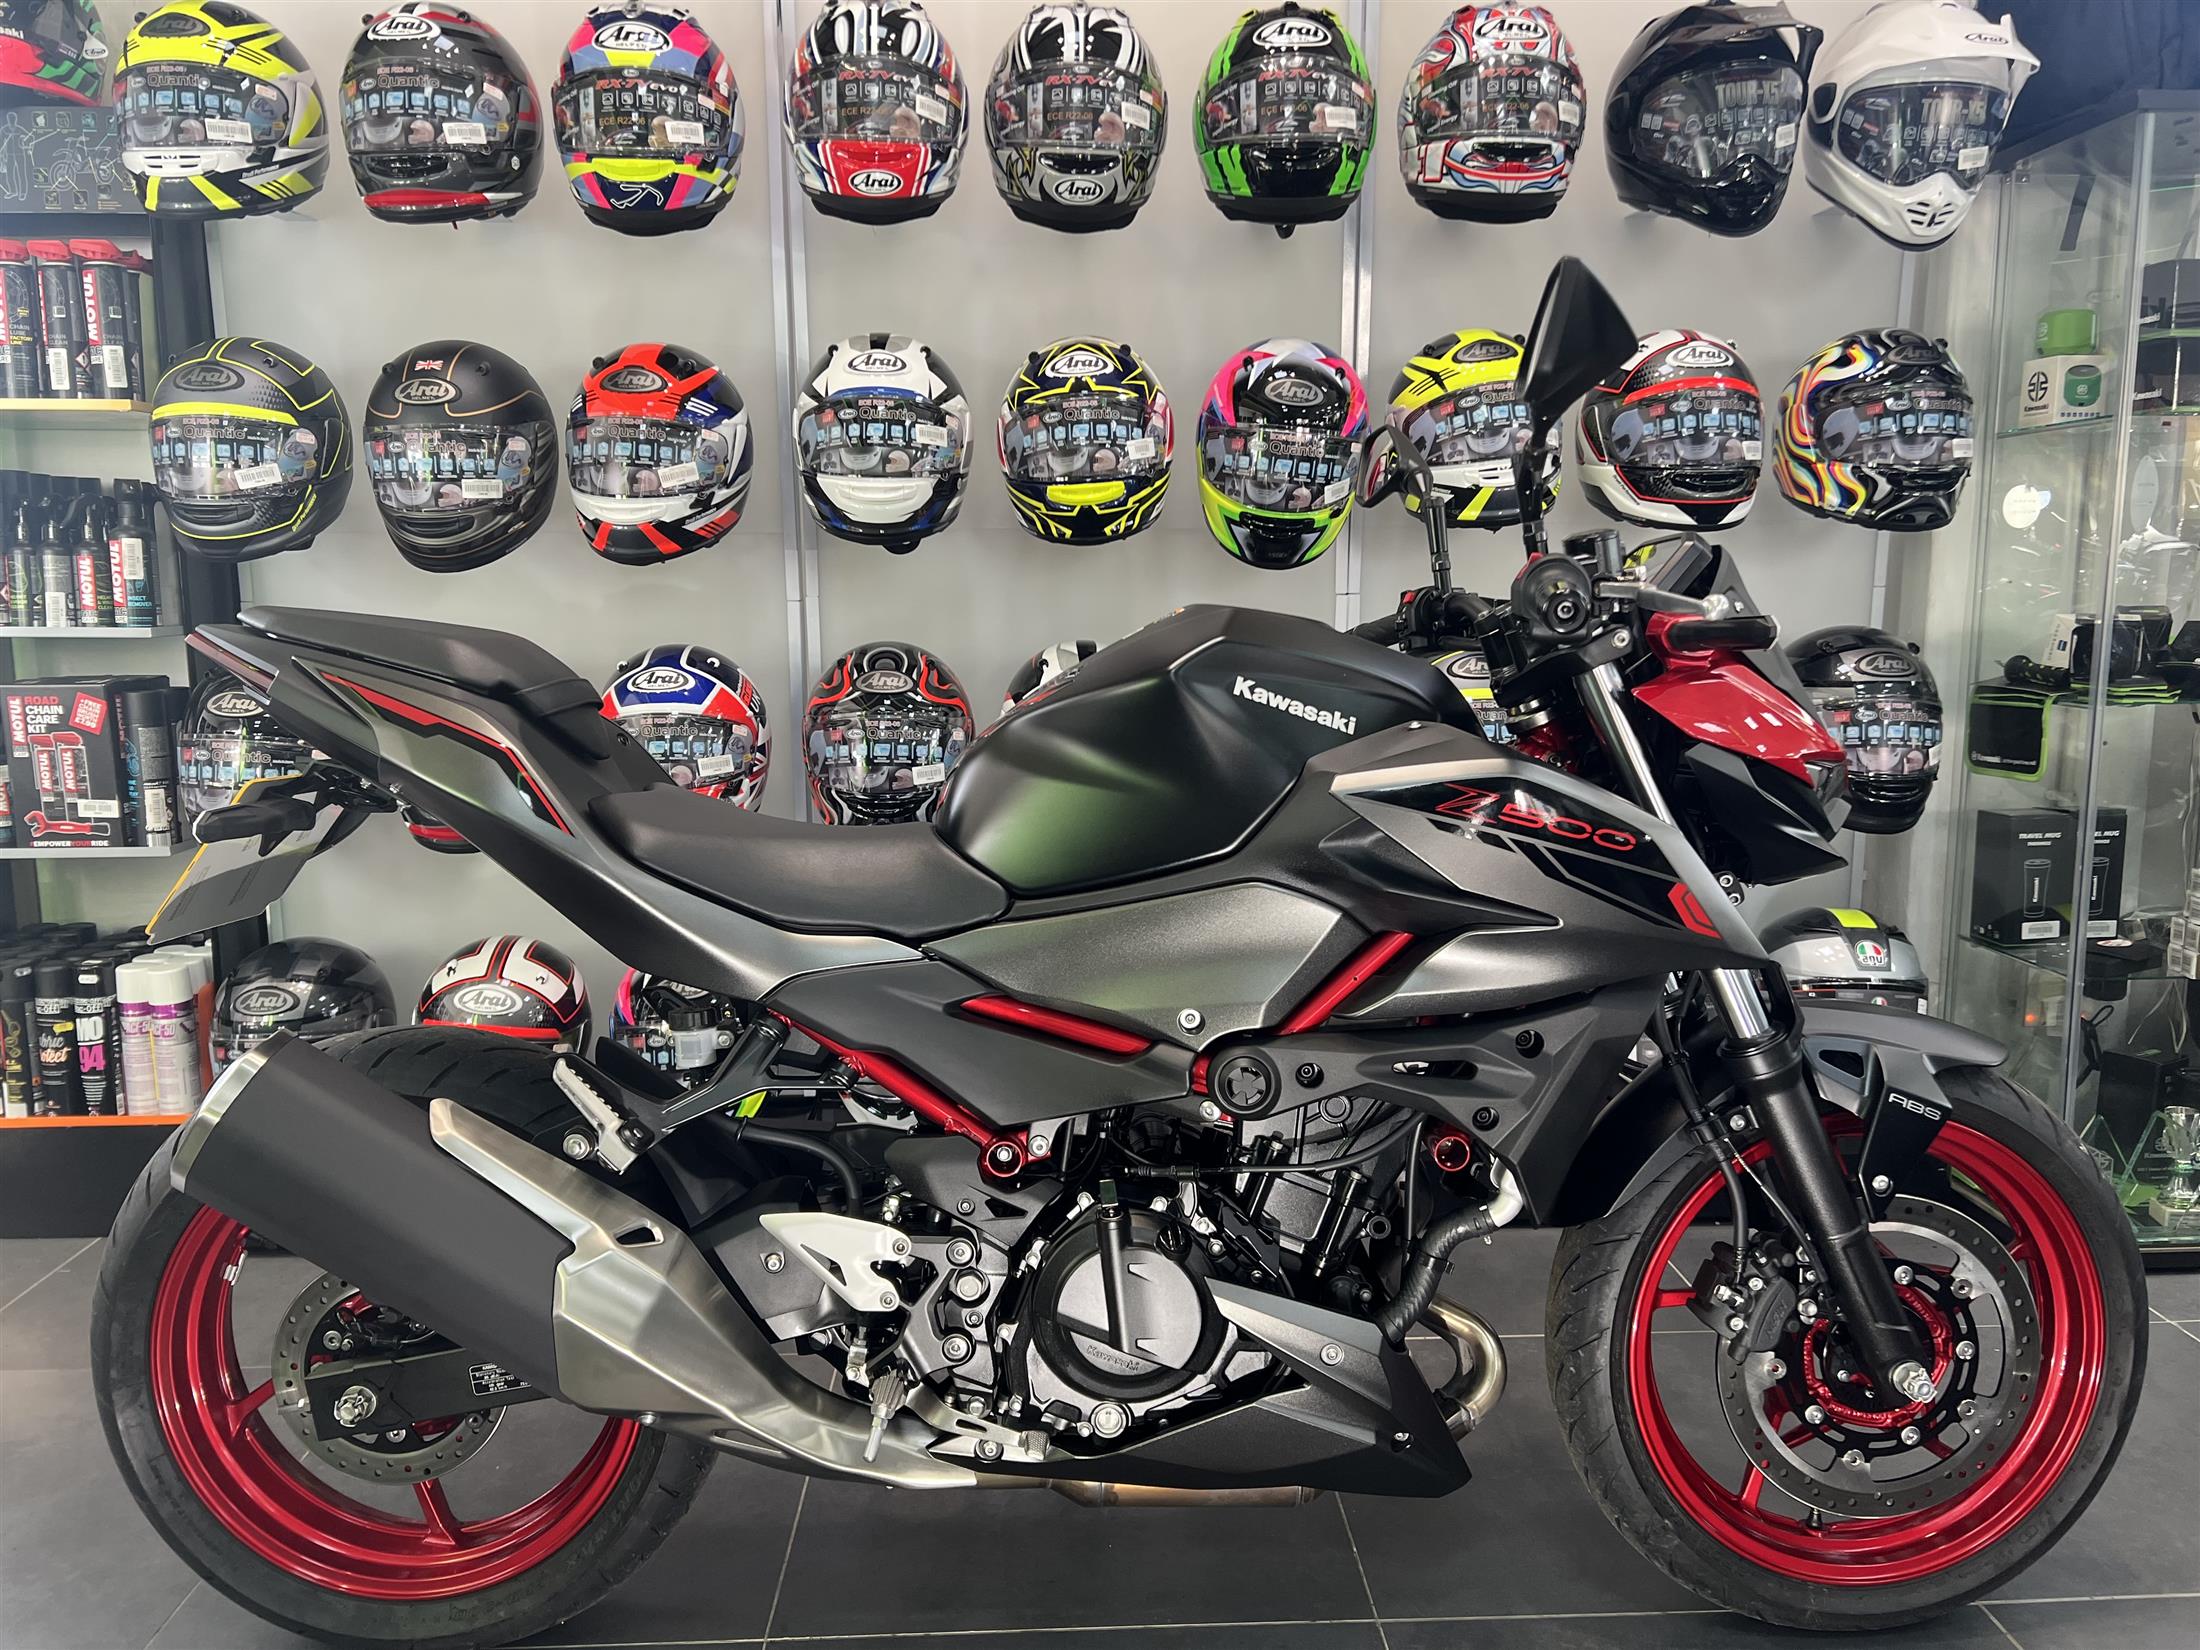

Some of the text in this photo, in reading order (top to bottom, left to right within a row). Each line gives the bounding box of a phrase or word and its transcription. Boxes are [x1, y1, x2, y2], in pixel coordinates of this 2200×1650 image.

[152, 17, 198, 32] Arai
[377, 16, 425, 31] Arai
[1264, 21, 1321, 38] Arai
[1480, 19, 1541, 34] Arai
[600, 26, 661, 44] Arai
[1970, 32, 2005, 43] Arai
[378, 74, 439, 88] Quantic
[1715, 81, 1780, 109] TOUR-X5
[841, 107, 858, 116] ECE
[1047, 111, 1093, 121] ECE R22-06
[599, 118, 616, 126] ECE
[854, 174, 896, 188] Arai
[1060, 182, 1098, 196] Arai
[84, 273, 99, 341] MOTUL
[1464, 343, 1508, 358] Arai
[1680, 347, 1722, 361] Arai
[855, 353, 900, 368] Arai
[1059, 356, 1101, 369] Arai
[181, 367, 229, 383] Arai
[609, 369, 655, 386] Arai
[402, 379, 447, 396] Arai
[1270, 381, 1317, 399] Arai
[859, 408, 916, 421] Quantic
[1064, 408, 1120, 420] Quantic
[183, 425, 246, 440] Quantic
[608, 425, 666, 441] Quantic
[1270, 441, 1325, 457] Quantic
[109, 543, 125, 604] MOTUL
[80, 557, 95, 607] MOTUL
[1866, 656, 1910, 670] Arai
[638, 672, 681, 685] Arai
[861, 673, 907, 687] Arai
[25, 696, 59, 704] ROAD
[211, 694, 258, 709] Arai
[1232, 675, 1357, 736] Kawasaki
[26, 705, 64, 714] CHAIN
[1879, 709, 1928, 722] Quantic
[10, 697, 26, 743] MOTUL
[27, 714, 60, 724] CARE
[28, 724, 48, 734] KIT
[641, 725, 698, 737] Quantic
[867, 727, 921, 740] Quantic
[39, 752, 53, 791] MOTUL
[62, 751, 77, 791] MOTUL
[1435, 782, 1638, 852] Z500
[242, 992, 287, 1008] Arai
[463, 990, 510, 1006] Arai
[1888, 1093, 1941, 1120] ABS
